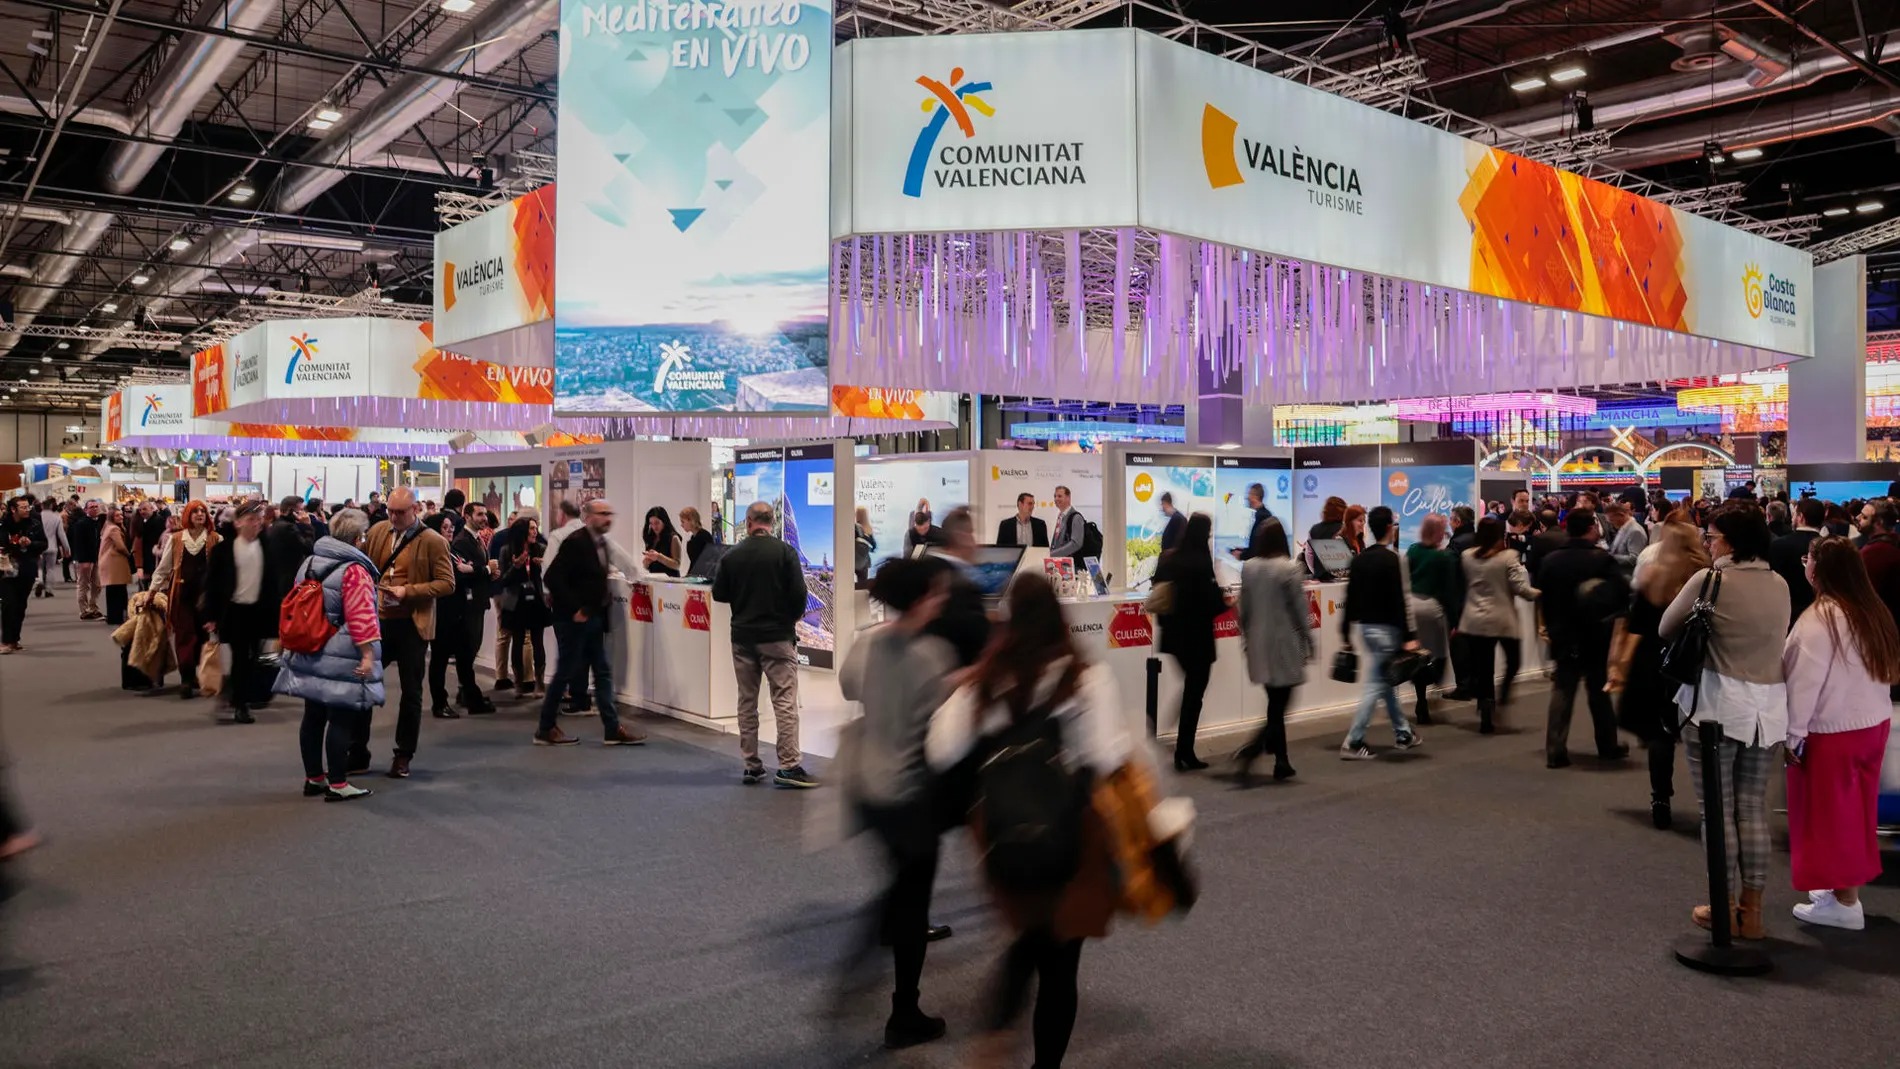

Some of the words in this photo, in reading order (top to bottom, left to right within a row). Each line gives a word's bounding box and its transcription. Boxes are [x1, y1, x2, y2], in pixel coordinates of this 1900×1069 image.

[671, 38, 709, 69] EN
[940, 142, 1084, 165] COMUNITAT
[1243, 138, 1363, 196] VALÈNCIA
[934, 165, 1086, 188] VALENCIANA
[1307, 189, 1363, 216] TURISME
[456, 256, 504, 290] VALÈNCIA
[479, 279, 504, 296] TURISME
[1769, 273, 1796, 297] Costa
[1763, 290, 1796, 315] Blanca
[298, 362, 350, 372] COMUNITAT
[487, 366, 506, 381] EN
[297, 371, 351, 381] VALENCIANA
[668, 371, 724, 381] COMUNITAT
[667, 380, 726, 390] VALENCIANA
[1601, 409, 1660, 421] MANCHA
[1133, 456, 1153, 464] CULLERA
[1114, 628, 1150, 641] CULLERA
